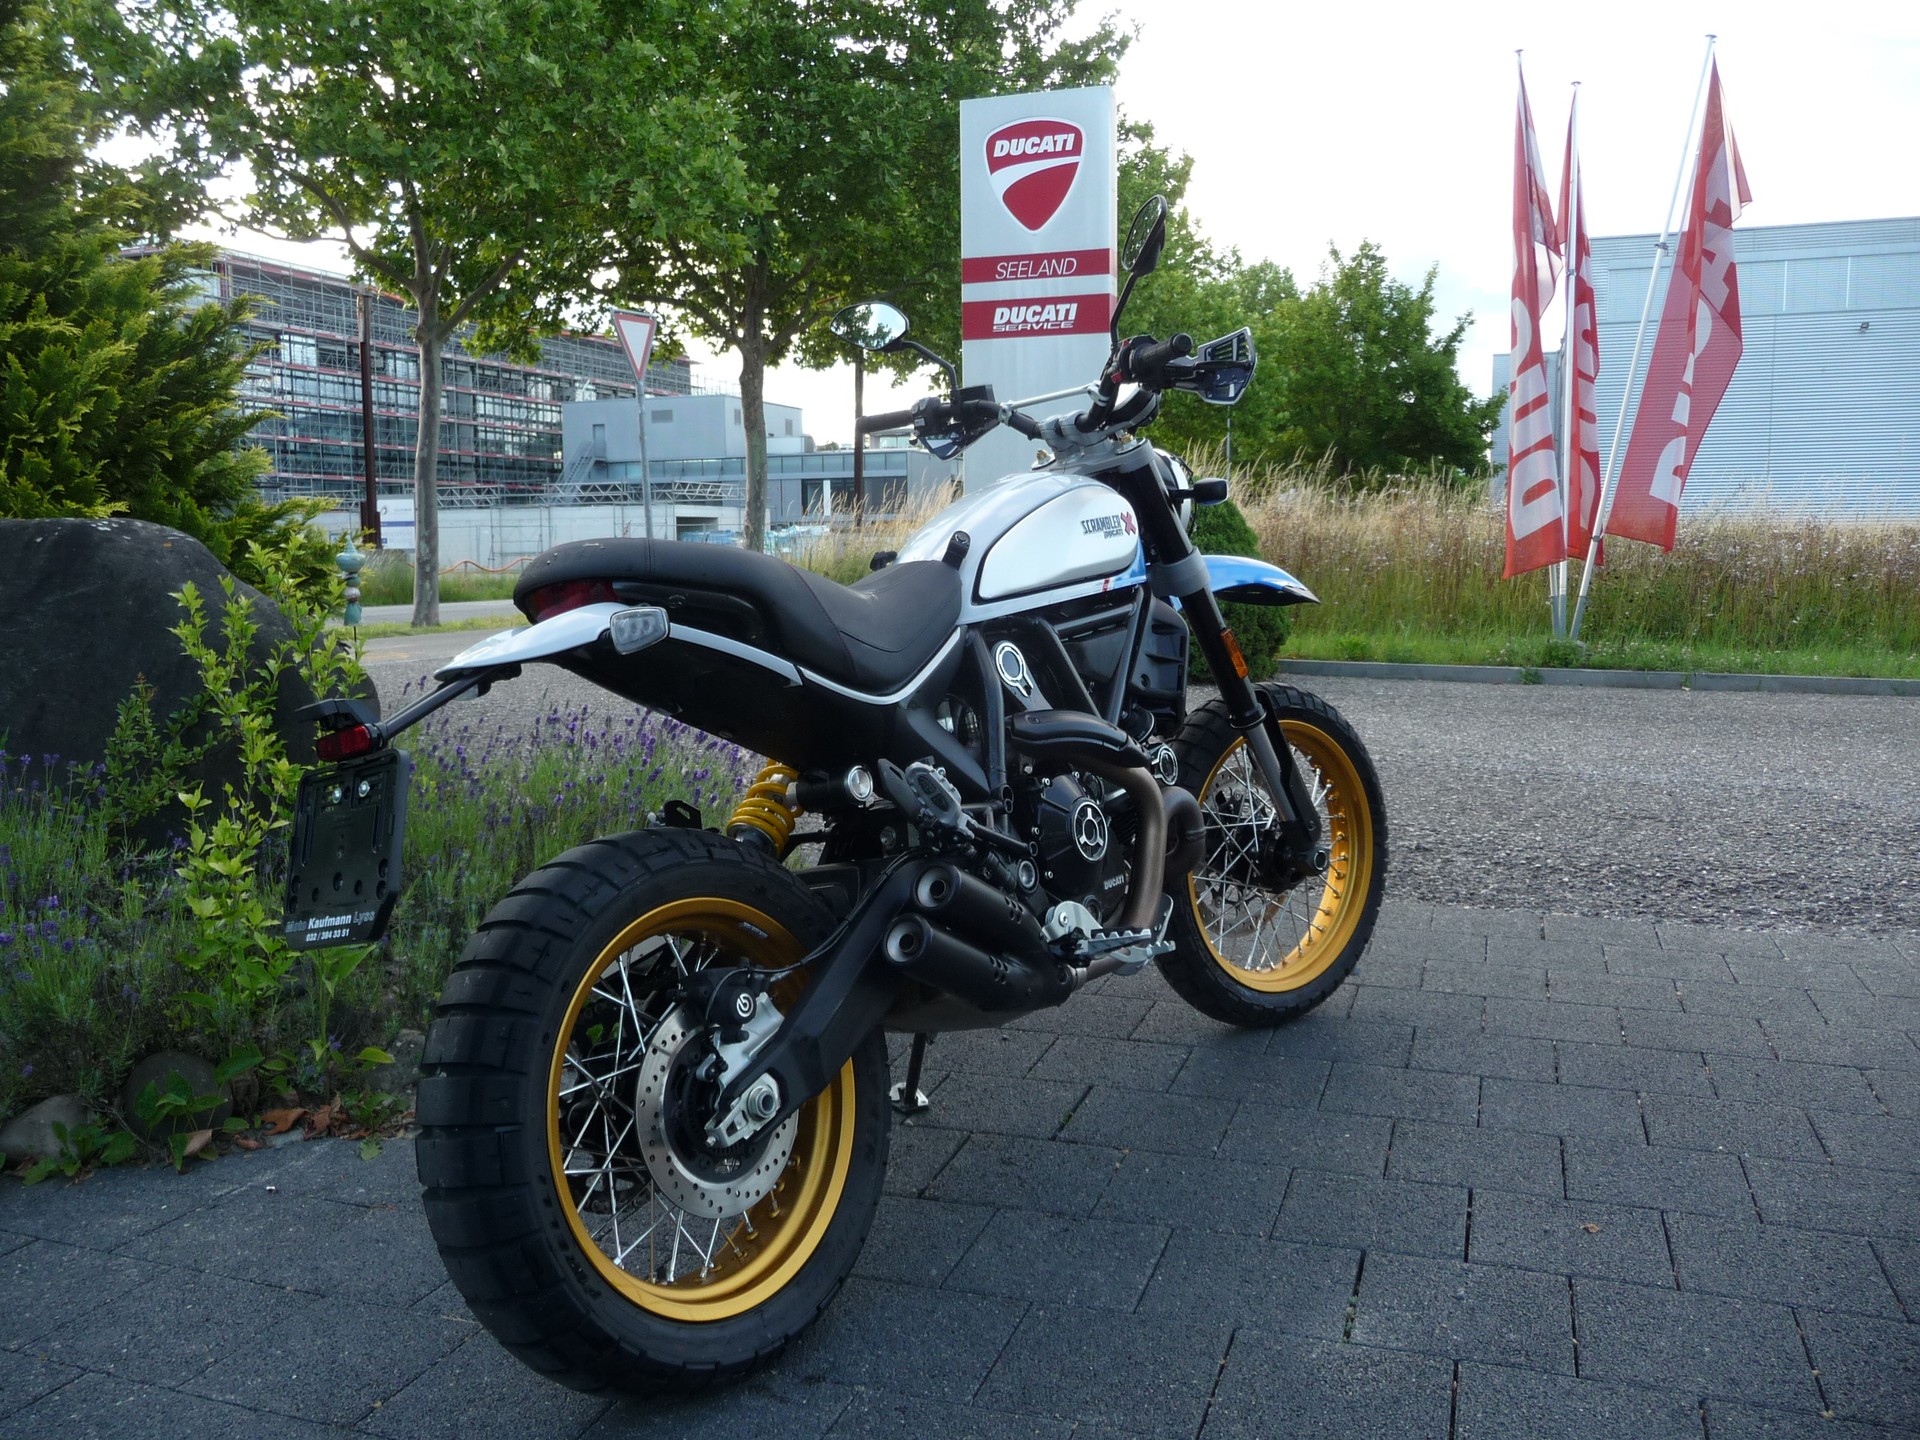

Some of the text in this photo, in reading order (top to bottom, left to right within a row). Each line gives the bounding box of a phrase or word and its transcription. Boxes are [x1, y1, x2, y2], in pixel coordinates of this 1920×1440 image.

[993, 133, 1075, 158] DUCATI
[995, 257, 1077, 280] SEELAND
[993, 303, 1078, 325] DUCATI
[993, 322, 1074, 333] SERVICE
[1081, 514, 1121, 534] SCRAMBLER
[1103, 528, 1124, 539] DUCATI
[1103, 874, 1125, 890] DUCATI
[308, 914, 352, 929] Kaufmann
[353, 911, 375, 925] Lyss
